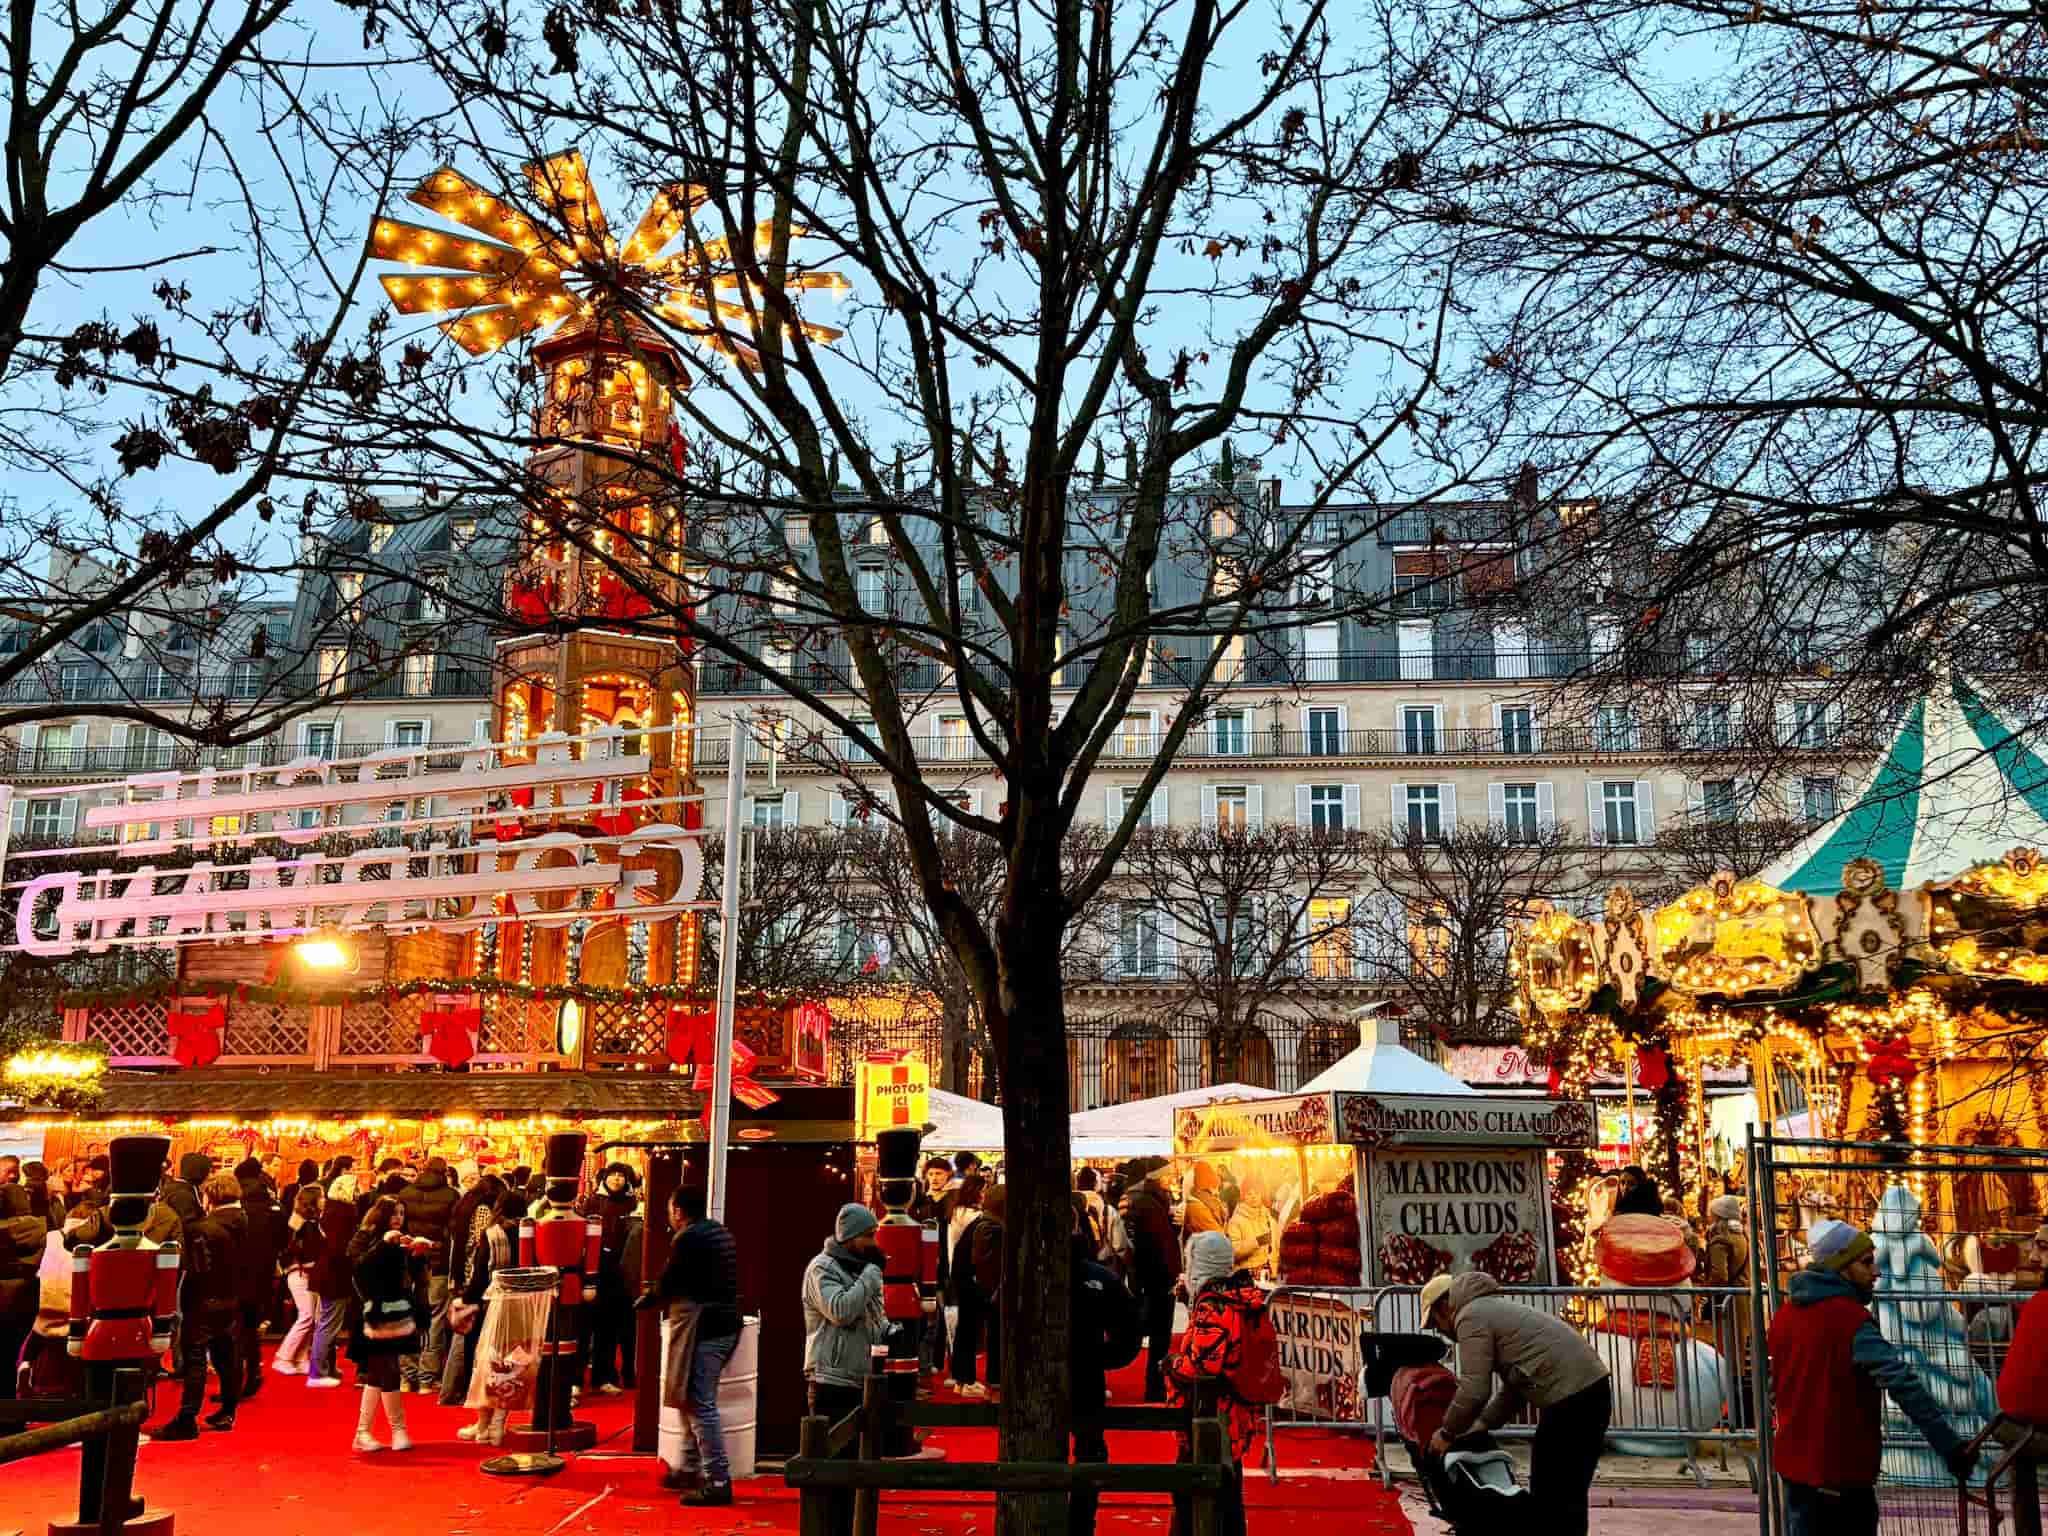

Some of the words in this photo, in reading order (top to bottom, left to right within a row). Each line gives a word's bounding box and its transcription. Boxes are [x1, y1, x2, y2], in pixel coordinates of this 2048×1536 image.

[876, 1083, 925, 1096] PHOTOS
[893, 1096, 908, 1106] ICI
[1365, 1109, 1480, 1132] MARRONS
[1484, 1111, 1571, 1136] CHAUDS
[1386, 1161, 1527, 1195] MARRONS
[1400, 1201, 1519, 1235] CHAUDS
[1271, 1307, 1351, 1345] ARRONS
[1279, 1340, 1344, 1377] HAUDS
